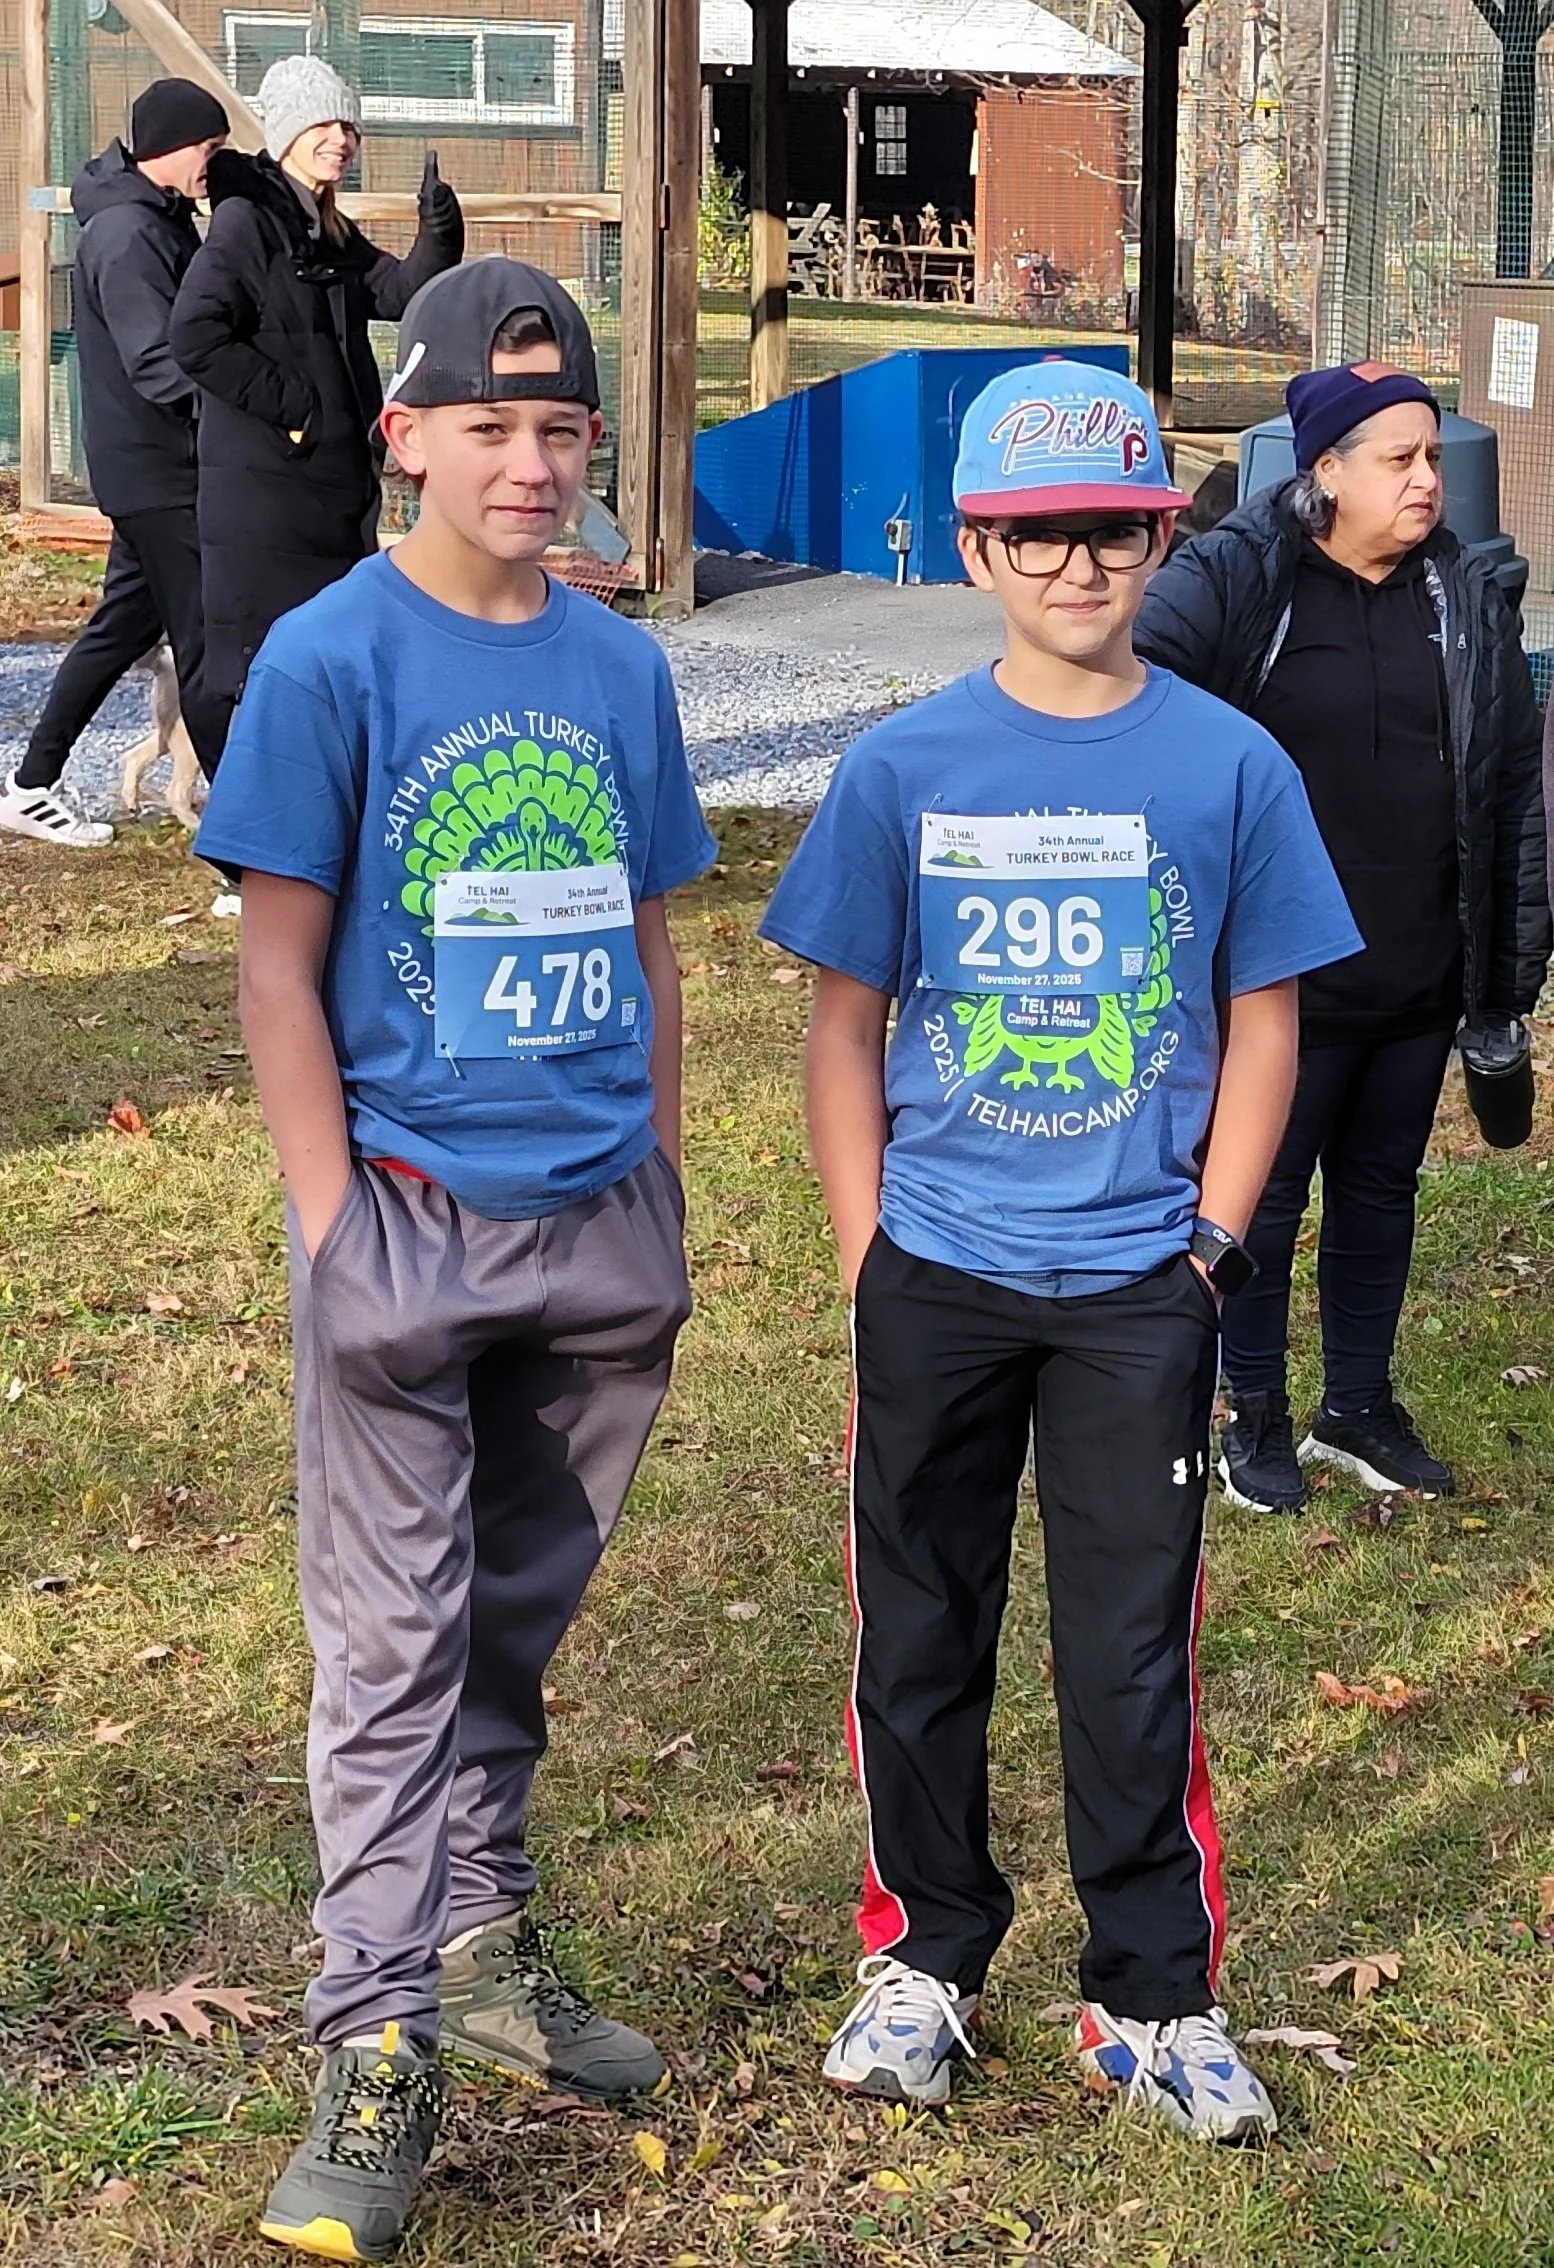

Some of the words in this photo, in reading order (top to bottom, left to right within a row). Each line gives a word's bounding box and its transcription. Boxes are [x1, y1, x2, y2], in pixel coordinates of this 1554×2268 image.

[385, 776, 427, 851] 34TH
[422, 711, 520, 782] ANNUAL
[524, 711, 610, 769] TURKEY
[943, 828, 957, 839] TEL
[958, 830, 974, 840] HAI
[1038, 836, 1064, 846] 34th
[1067, 836, 1104, 845] Annual
[937, 839, 952, 847] Camp
[1006, 852, 1058, 864] TURKEY
[1062, 851, 1098, 863] BOWL
[1102, 851, 1136, 862] RACE
[467, 885, 487, 897] TEL
[490, 886, 509, 897] HAI
[568, 888, 585, 900] 34th
[587, 885, 608, 898] Annual
[458, 897, 481, 905] Camp
[483, 897, 488, 905] &
[490, 897, 517, 905] Retreat
[1160, 865, 1195, 948] BOWL
[543, 904, 582, 920] TURKEY
[584, 901, 606, 916] BOWL
[608, 899, 625, 912] RACE
[957, 896, 1104, 968] 296
[977, 973, 1032, 985] November
[1034, 973, 1051, 986] 27,
[1053, 973, 1082, 985] 2025
[483, 948, 611, 1028] 478
[1020, 994, 1049, 1014] TEL
[1052, 999, 1081, 1016] HAI
[1007, 1013, 1038, 1027] Camp
[1041, 1015, 1048, 1026] &
[1051, 1015, 1091, 1028] Retreat
[508, 1033, 563, 1047] November
[565, 1031, 577, 1043] 27,
[578, 1029, 597, 1041] 2025
[923, 1014, 960, 1083] 2025
[966, 1030, 1179, 1139] TELHAICAMP.ORG
